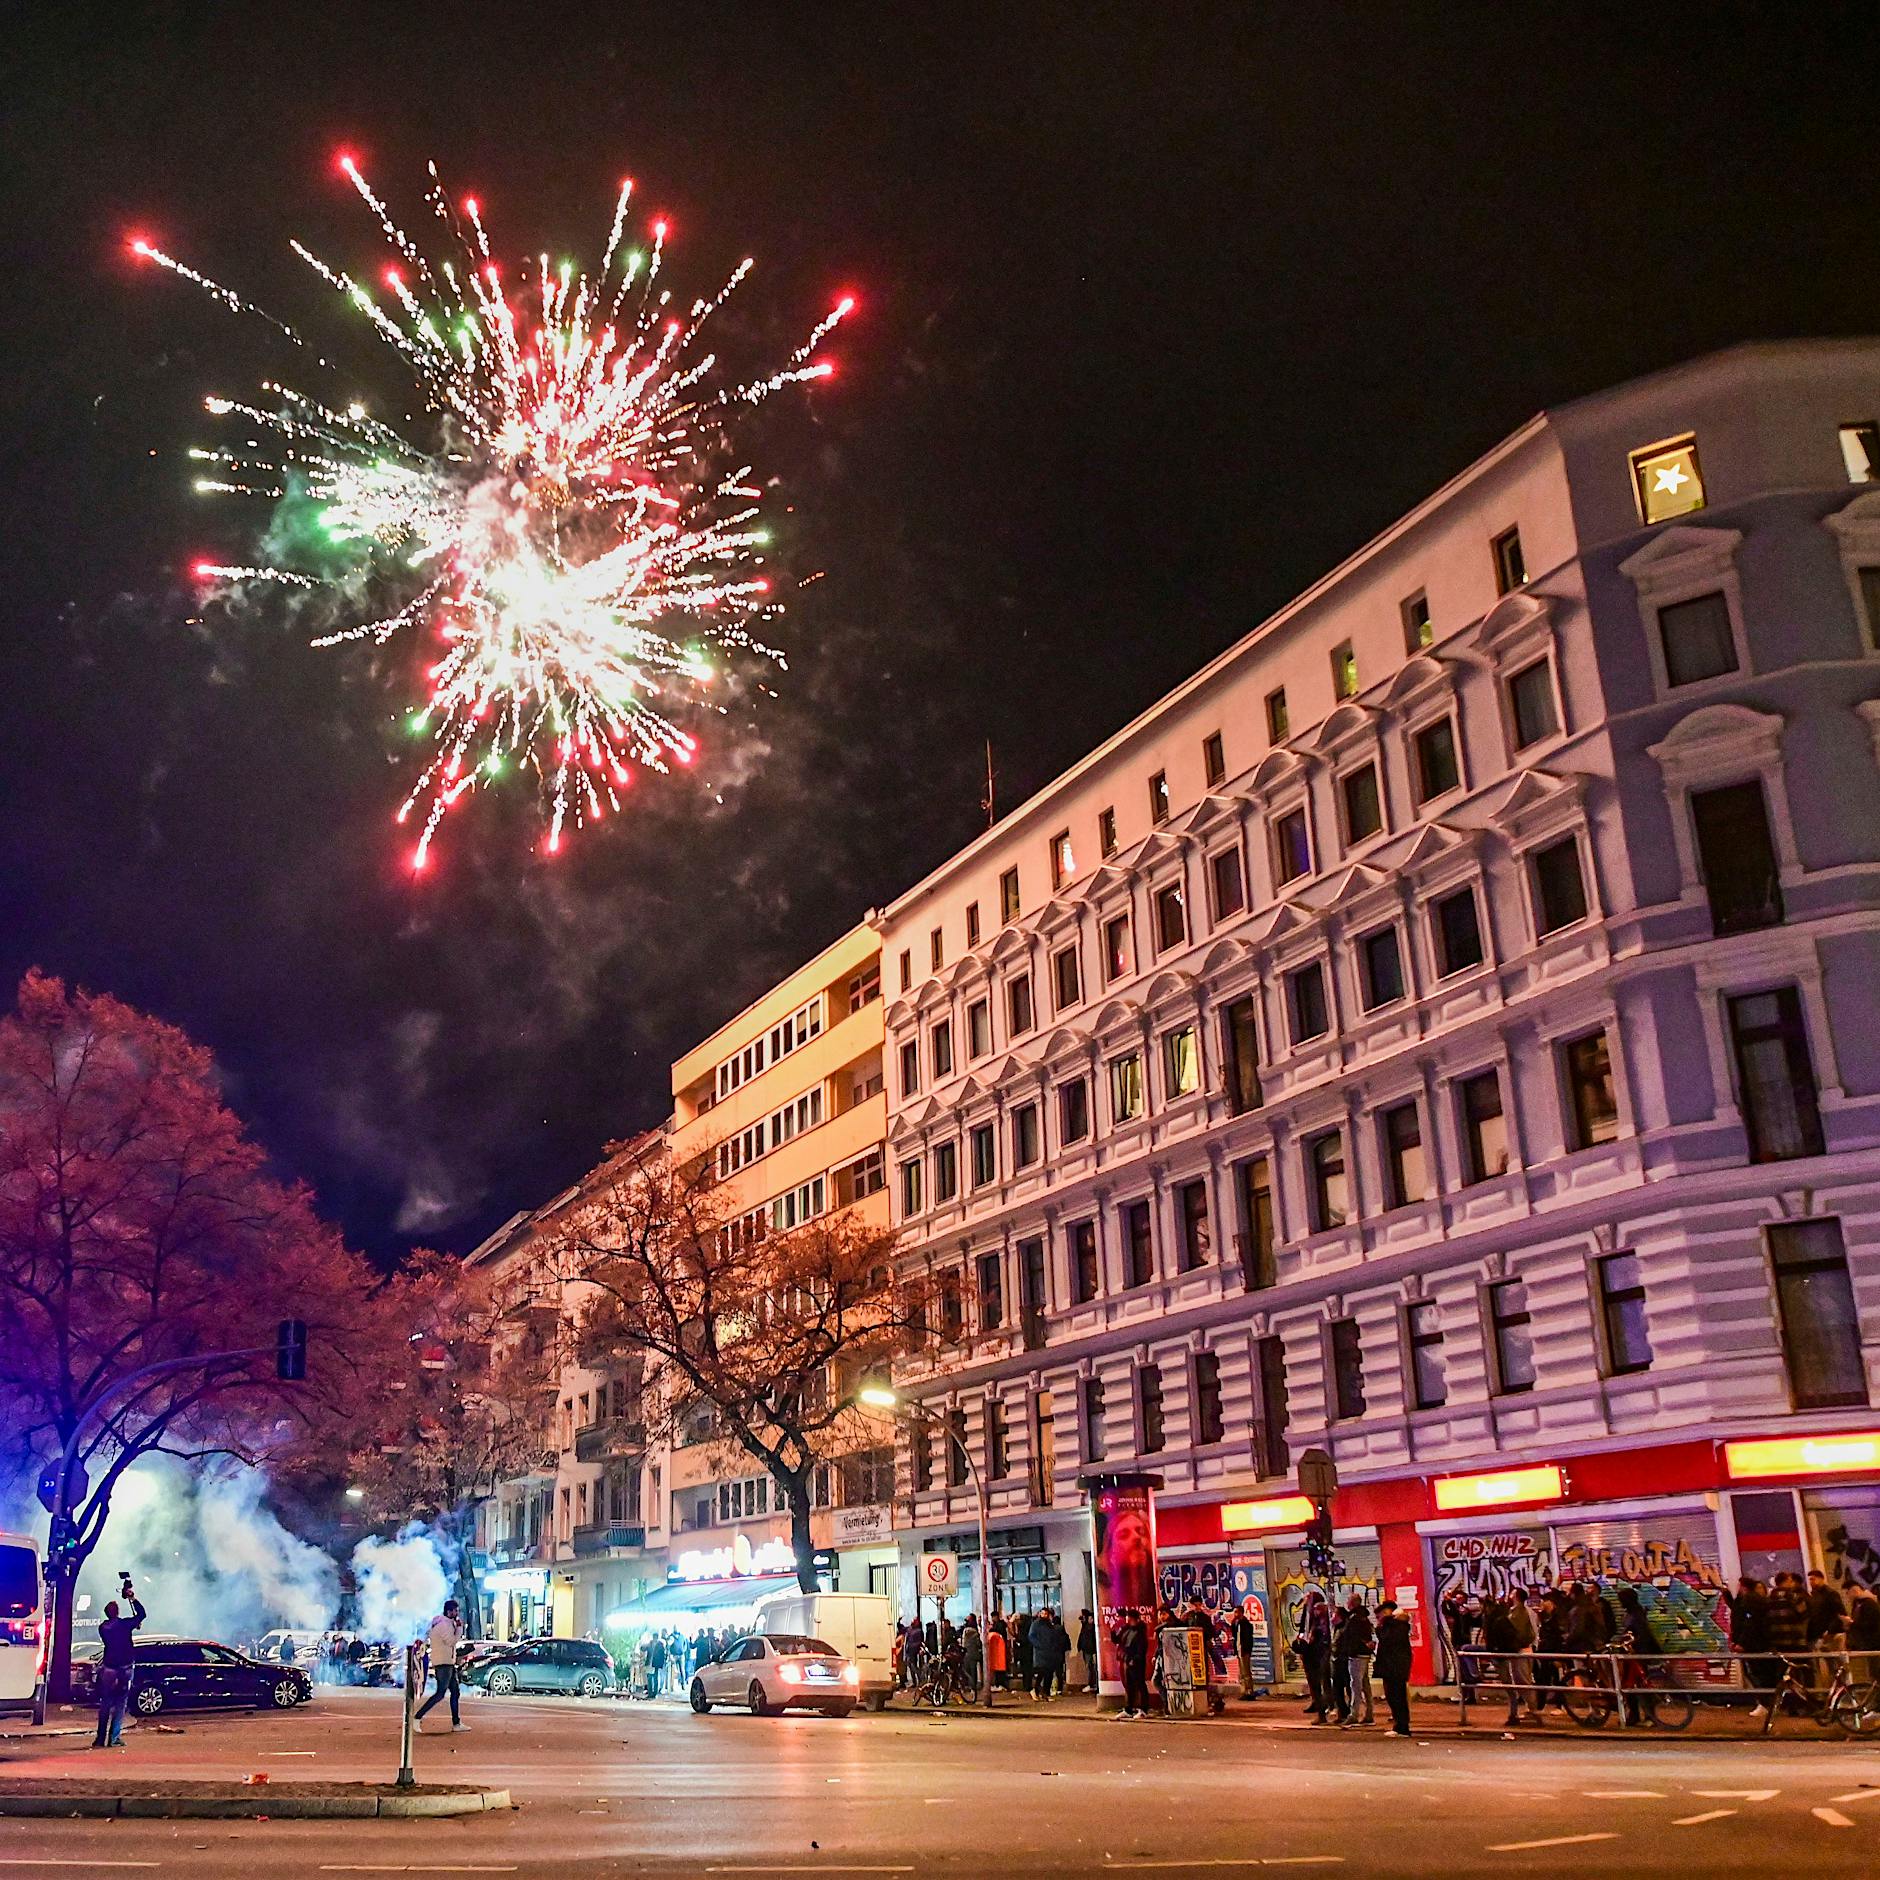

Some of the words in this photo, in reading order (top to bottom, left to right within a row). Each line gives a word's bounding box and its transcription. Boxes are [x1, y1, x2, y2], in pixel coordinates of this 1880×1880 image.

[1562, 1543, 1619, 1580] THE
[931, 1564, 945, 1577] 30
[24, 1629, 34, 1638] E1
